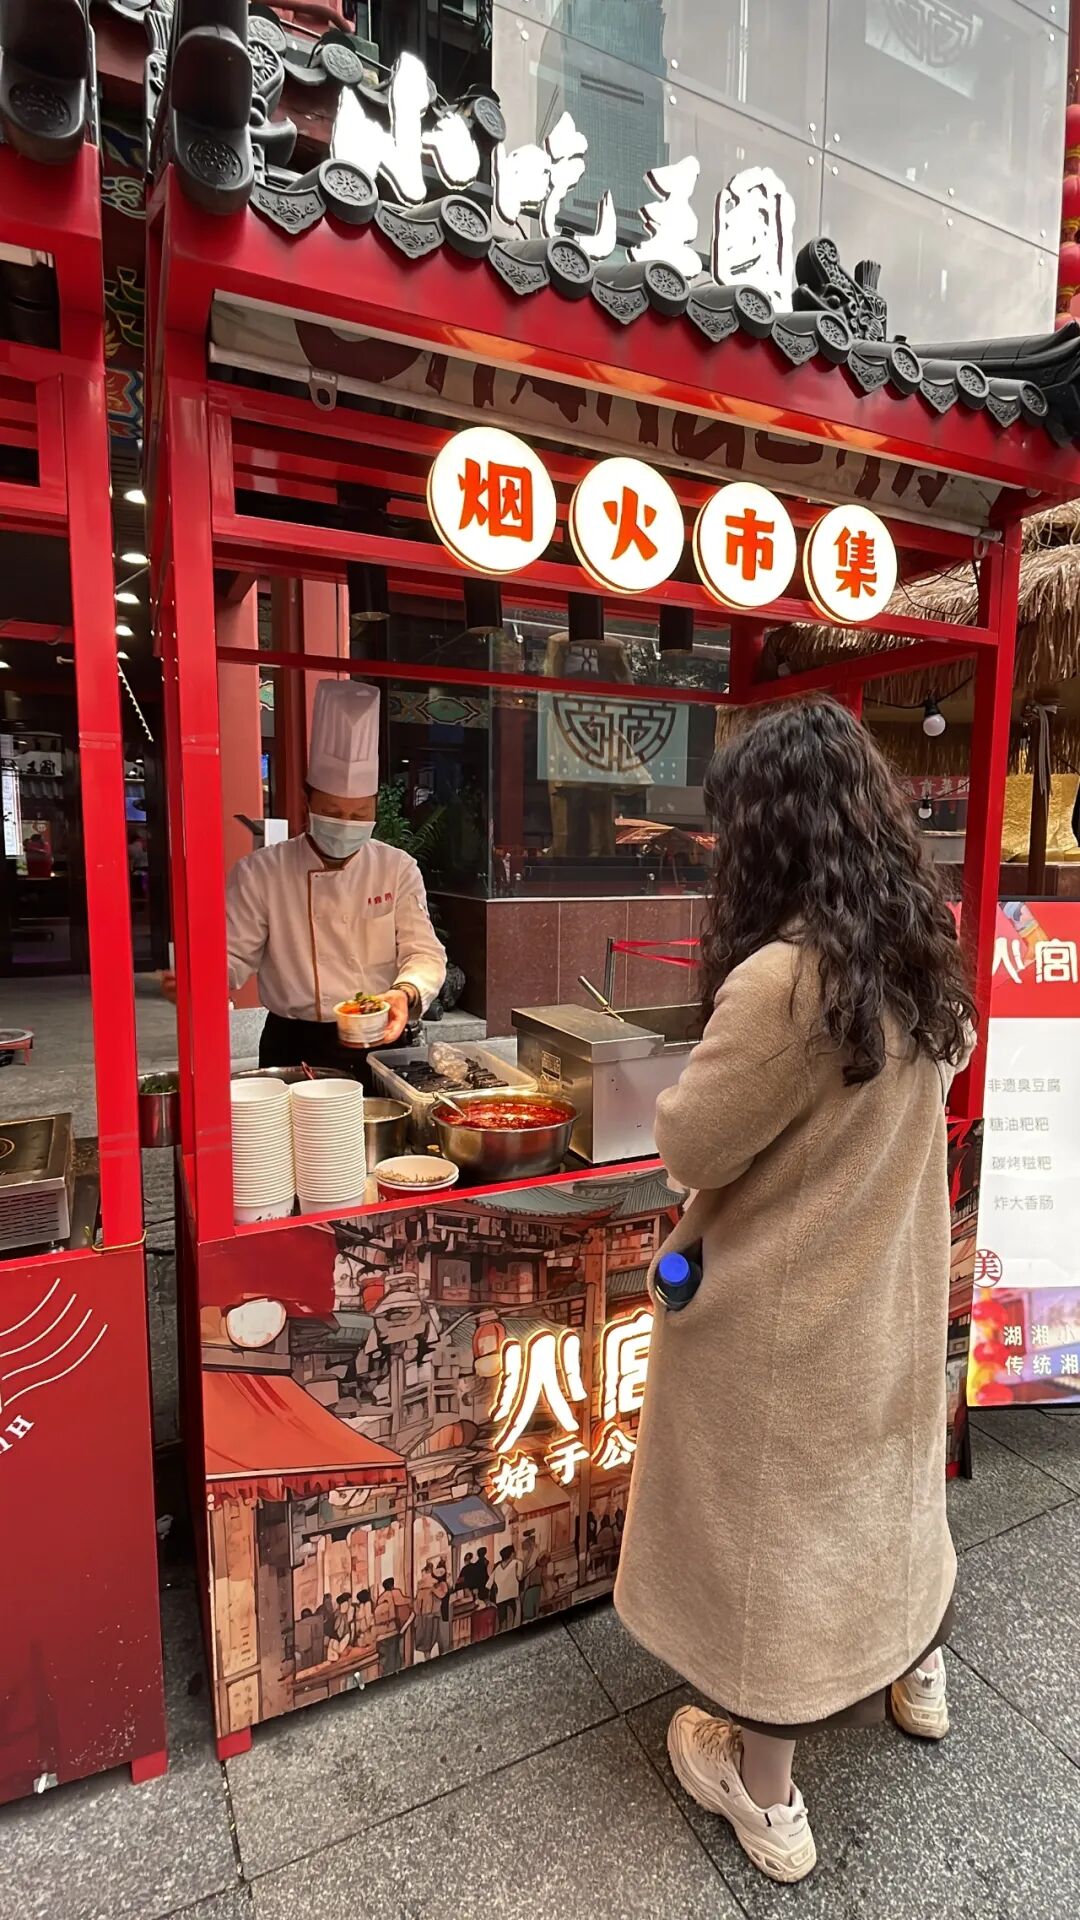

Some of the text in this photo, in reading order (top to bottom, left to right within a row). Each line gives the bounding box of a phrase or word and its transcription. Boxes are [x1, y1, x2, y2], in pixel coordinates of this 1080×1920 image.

[458, 457, 878, 599] 烟火市集
[987, 1077, 1061, 1093] 非遗臭豆腐
[988, 1116, 1050, 1132] 糖油粑粑
[991, 1155, 1052, 1171] 碳烤糍粑
[993, 1194, 1054, 1211] 炸大香肠
[973, 1250, 1001, 1283] 美
[1005, 1354, 1079, 1376] 传统湘
